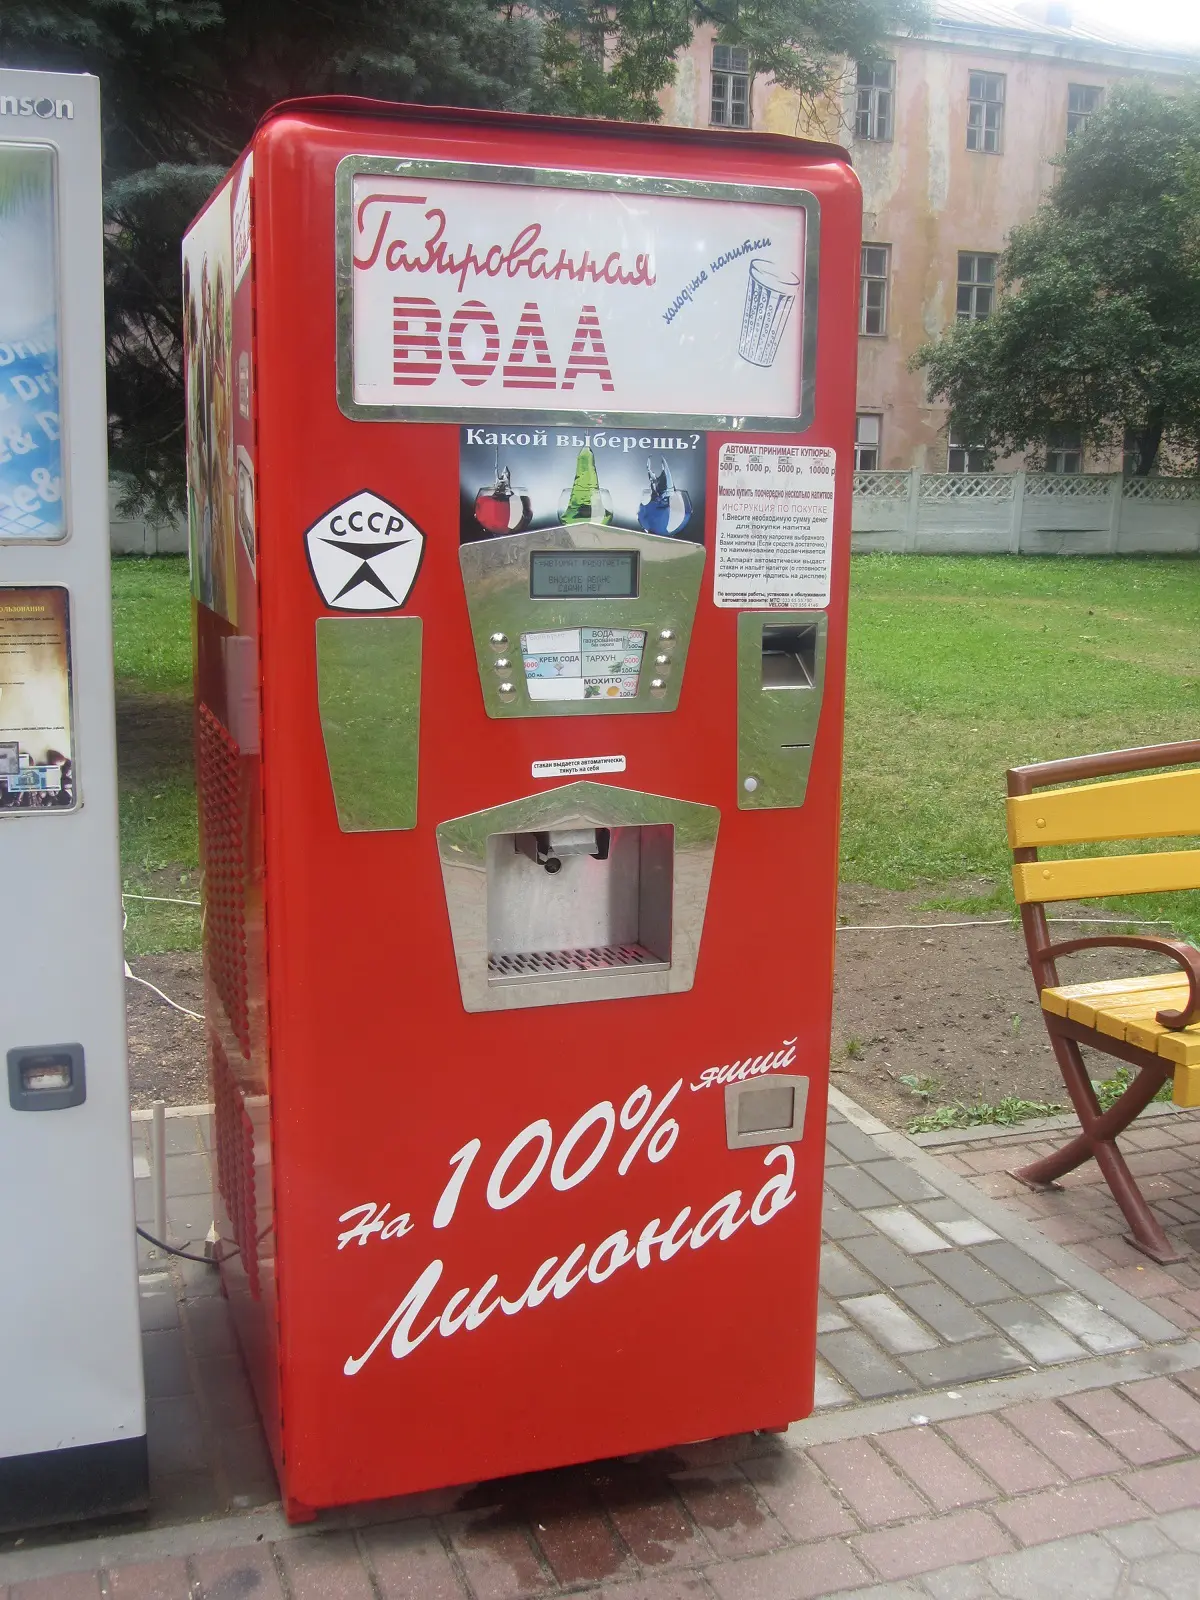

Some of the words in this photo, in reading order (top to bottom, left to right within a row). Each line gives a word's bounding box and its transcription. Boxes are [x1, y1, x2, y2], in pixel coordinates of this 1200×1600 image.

[353, 193, 656, 293] Газированная
[662, 270, 708, 325] холодные
[710, 237, 772, 273] напитки
[393, 296, 615, 392] ВОДА
[466, 428, 548, 446] Какой
[556, 432, 701, 452] выберешь?
[726, 445, 758, 454] АВТОМАТ
[758, 446, 800, 457] ПРИНИМАЕТ
[800, 448, 832, 457] КУПЮРЫ:
[719, 463, 733, 471] 500
[745, 464, 763, 472] 1000
[777, 465, 795, 473] 5000
[809, 466, 830, 475] 10000
[718, 485, 736, 497] Можно
[736, 488, 754, 499] купить
[754, 488, 784, 500] поочередно
[784, 489, 811, 499] несколько
[810, 491, 834, 500] напитков
[722, 503, 776, 513] ИНСТРУКЦИЯ
[777, 504, 790, 513] ПО
[791, 504, 828, 514] ПОКУПКЕ
[329, 510, 404, 537] СССР
[751, 513, 792, 523] необходимую
[792, 516, 811, 525] сумму
[811, 516, 829, 524] денег
[756, 540, 772, 548] (Если
[793, 534, 825, 542] выбранного
[726, 556, 753, 564] Аппарат
[802, 558, 826, 566] выдаст
[718, 572, 761, 580] информирует
[591, 630, 614, 639] ВОДА
[585, 654, 617, 663] ТАРХУН
[584, 677, 622, 685] МОХИТО
[553, 760, 580, 768] выдается
[586, 764, 600, 772] себя
[338, 1203, 415, 1250] На
[432, 1077, 683, 1229] 100%
[690, 1036, 798, 1091] ящий
[343, 1145, 796, 1376] Лимонад
